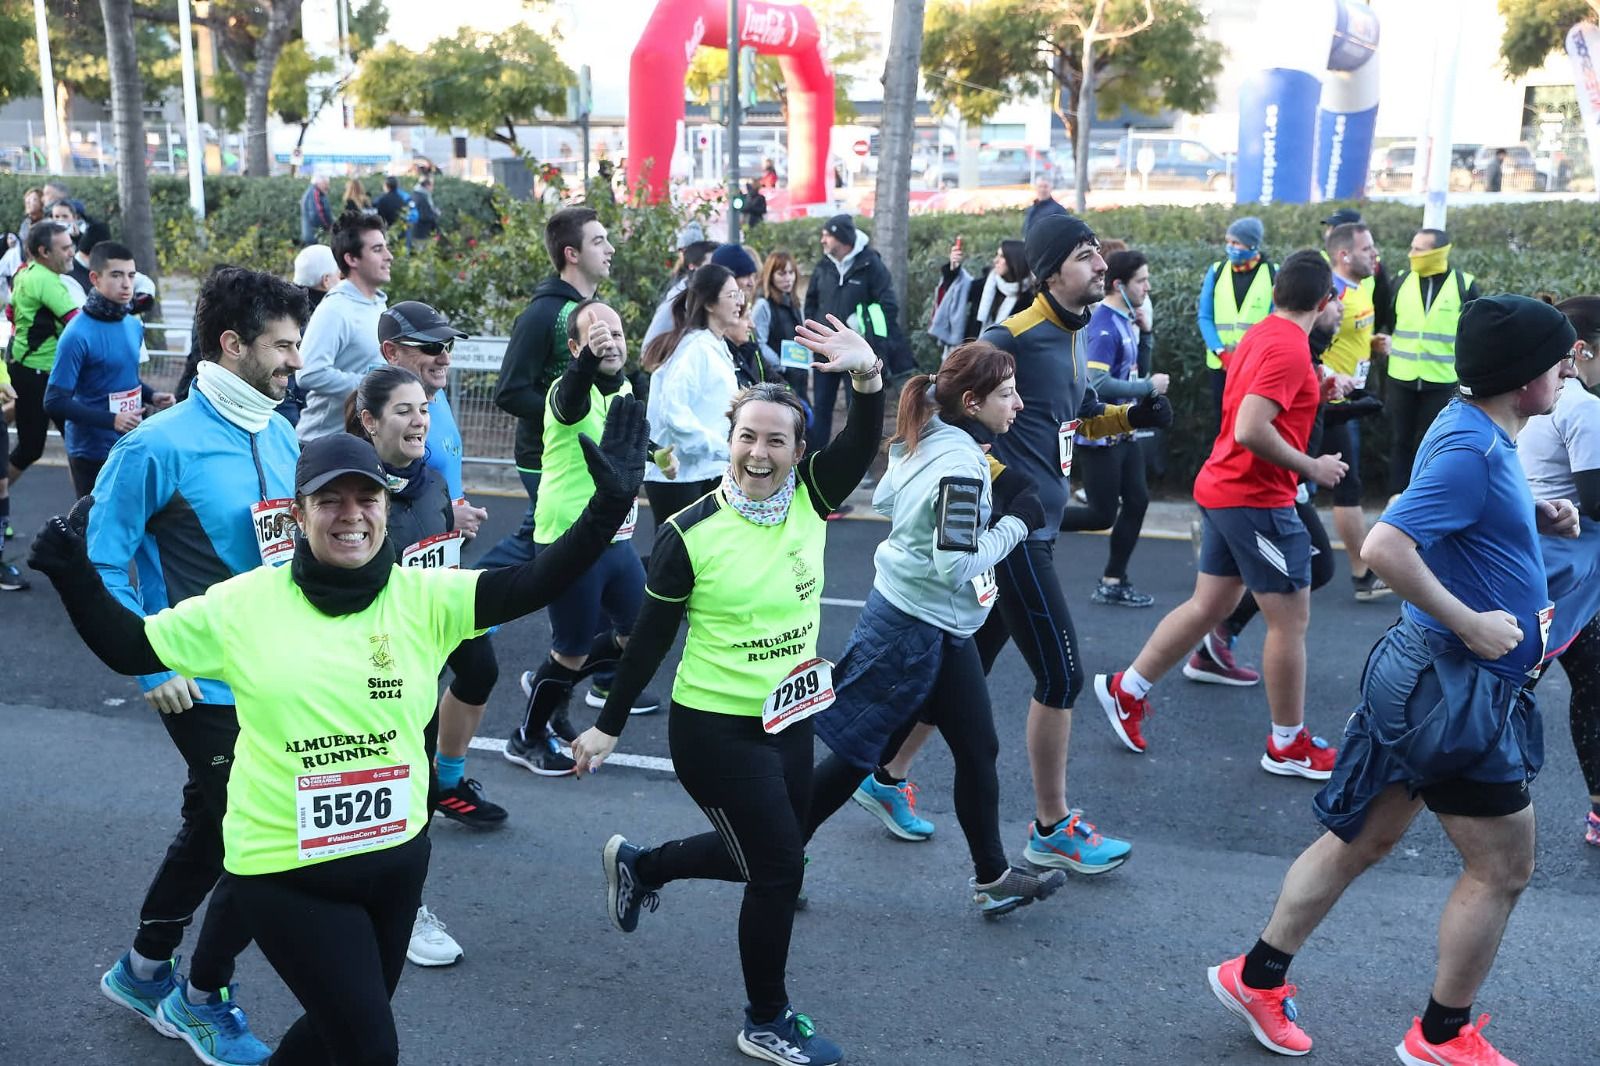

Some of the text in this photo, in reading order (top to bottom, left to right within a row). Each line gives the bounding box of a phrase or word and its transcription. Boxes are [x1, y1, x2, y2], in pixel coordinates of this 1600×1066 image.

[1258, 103, 1278, 206] tersport.es
[795, 577, 816, 592] Since
[367, 677, 403, 688] Since
[369, 689, 402, 699] 2014
[313, 787, 392, 828] 5526
